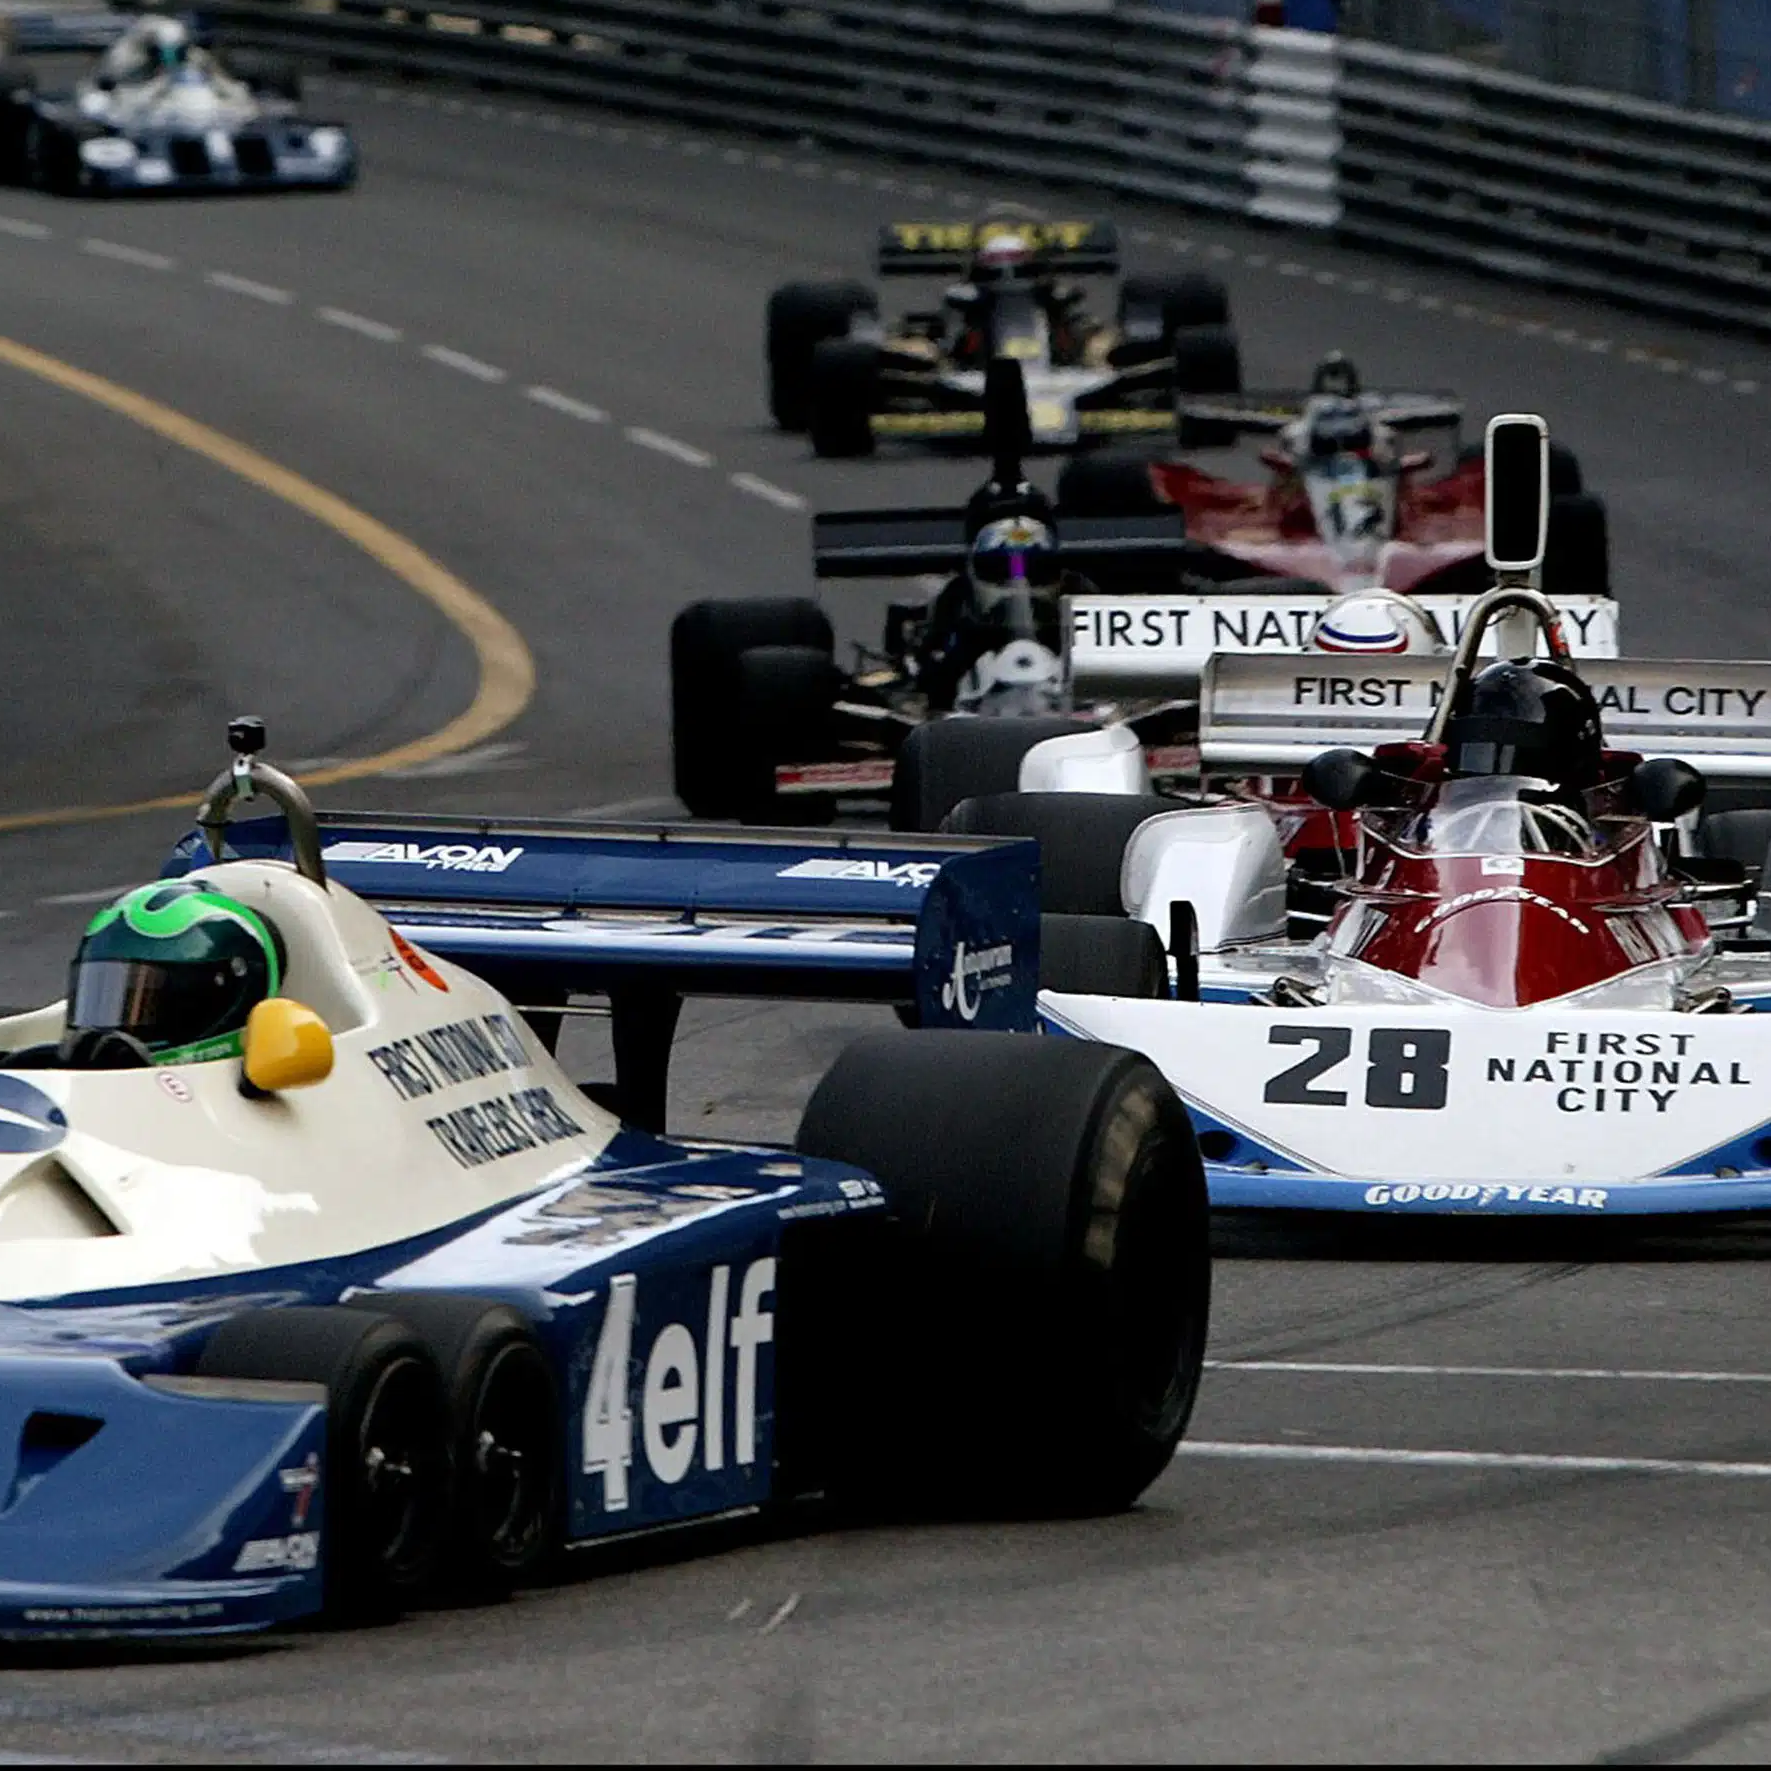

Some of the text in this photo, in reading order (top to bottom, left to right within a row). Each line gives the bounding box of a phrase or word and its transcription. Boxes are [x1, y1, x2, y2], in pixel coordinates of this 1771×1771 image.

[1072, 609, 1191, 647] FIRST
[1293, 677, 1411, 706] FIRST
[1662, 685, 1766, 716] CITY
[365, 843, 525, 865] AVON
[1545, 1031, 1696, 1056] FIRST
[1263, 1024, 1452, 1110] 28
[1486, 1057, 1752, 1086] NATIONAL
[1556, 1087, 1679, 1114] CITY
[1363, 1183, 1609, 1210] GOODYEAR
[581, 1255, 778, 1513] 4 elf
